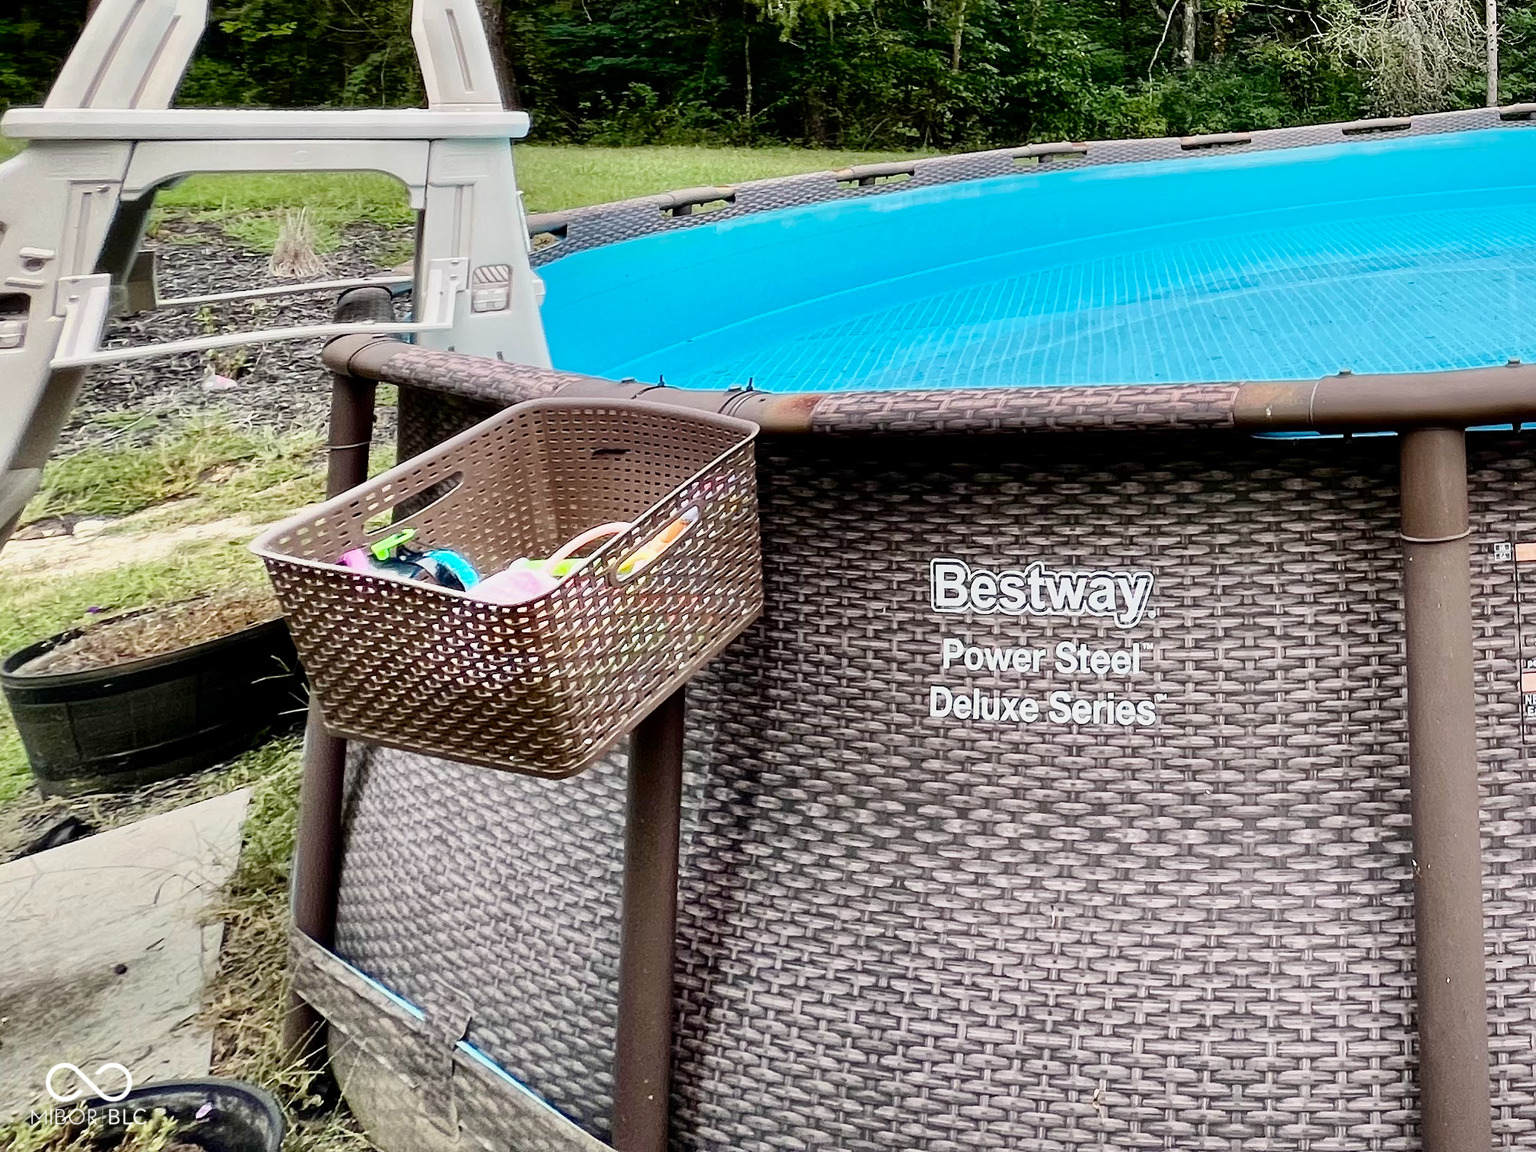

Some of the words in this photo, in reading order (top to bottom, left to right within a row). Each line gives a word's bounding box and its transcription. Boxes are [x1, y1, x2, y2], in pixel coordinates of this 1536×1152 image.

[930, 557, 1154, 628] Bestway
[943, 638, 1046, 673] Power
[930, 686, 1039, 723] Deluxe
